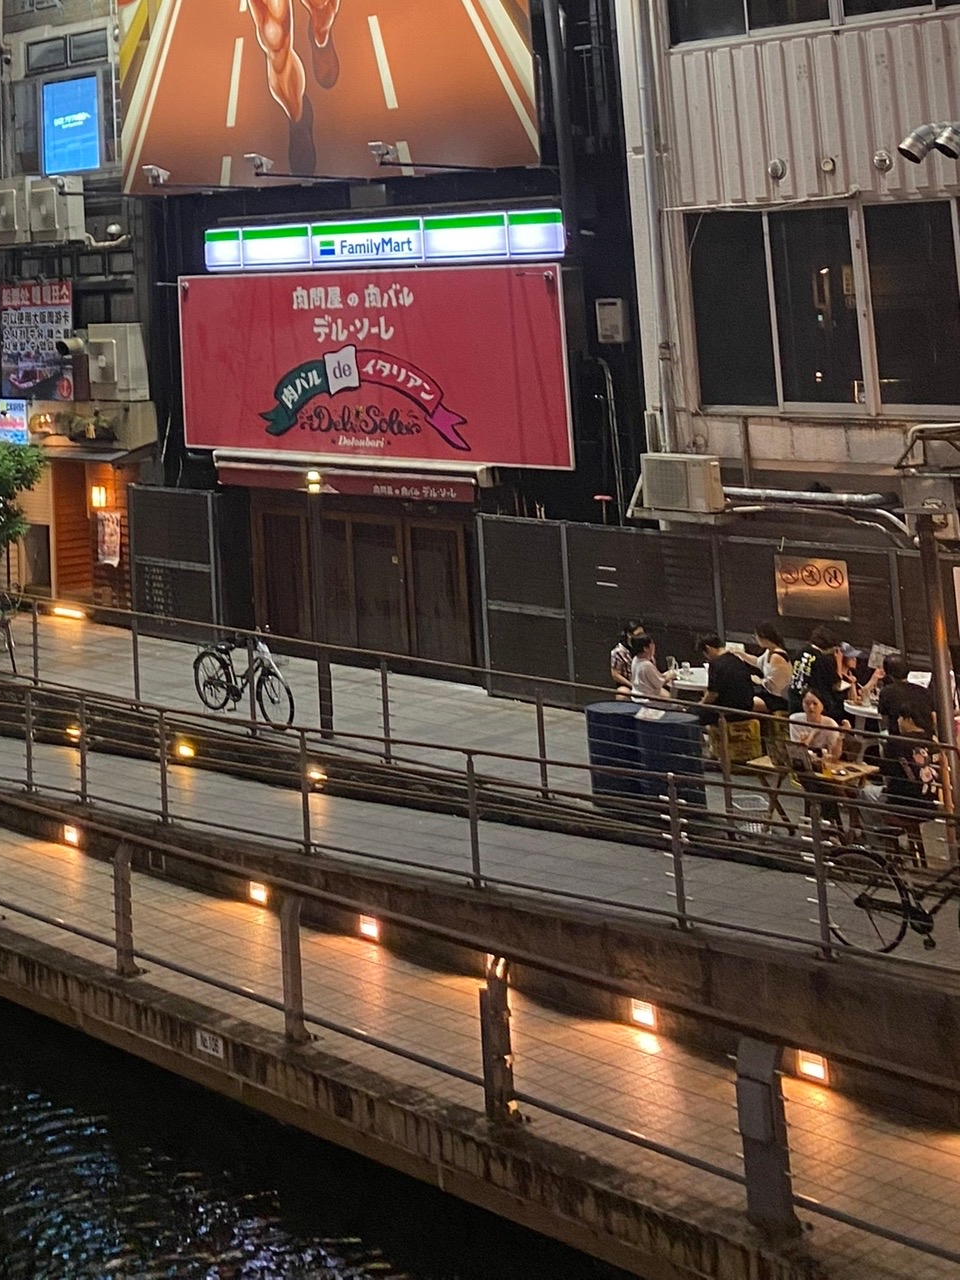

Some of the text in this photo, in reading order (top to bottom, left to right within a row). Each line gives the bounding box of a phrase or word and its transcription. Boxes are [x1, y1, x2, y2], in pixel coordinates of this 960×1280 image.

[340, 237, 413, 256] FamilyMart
[313, 314, 394, 343] デル・ソーレ
[280, 359, 435, 409] 肉バル de イタリアン
